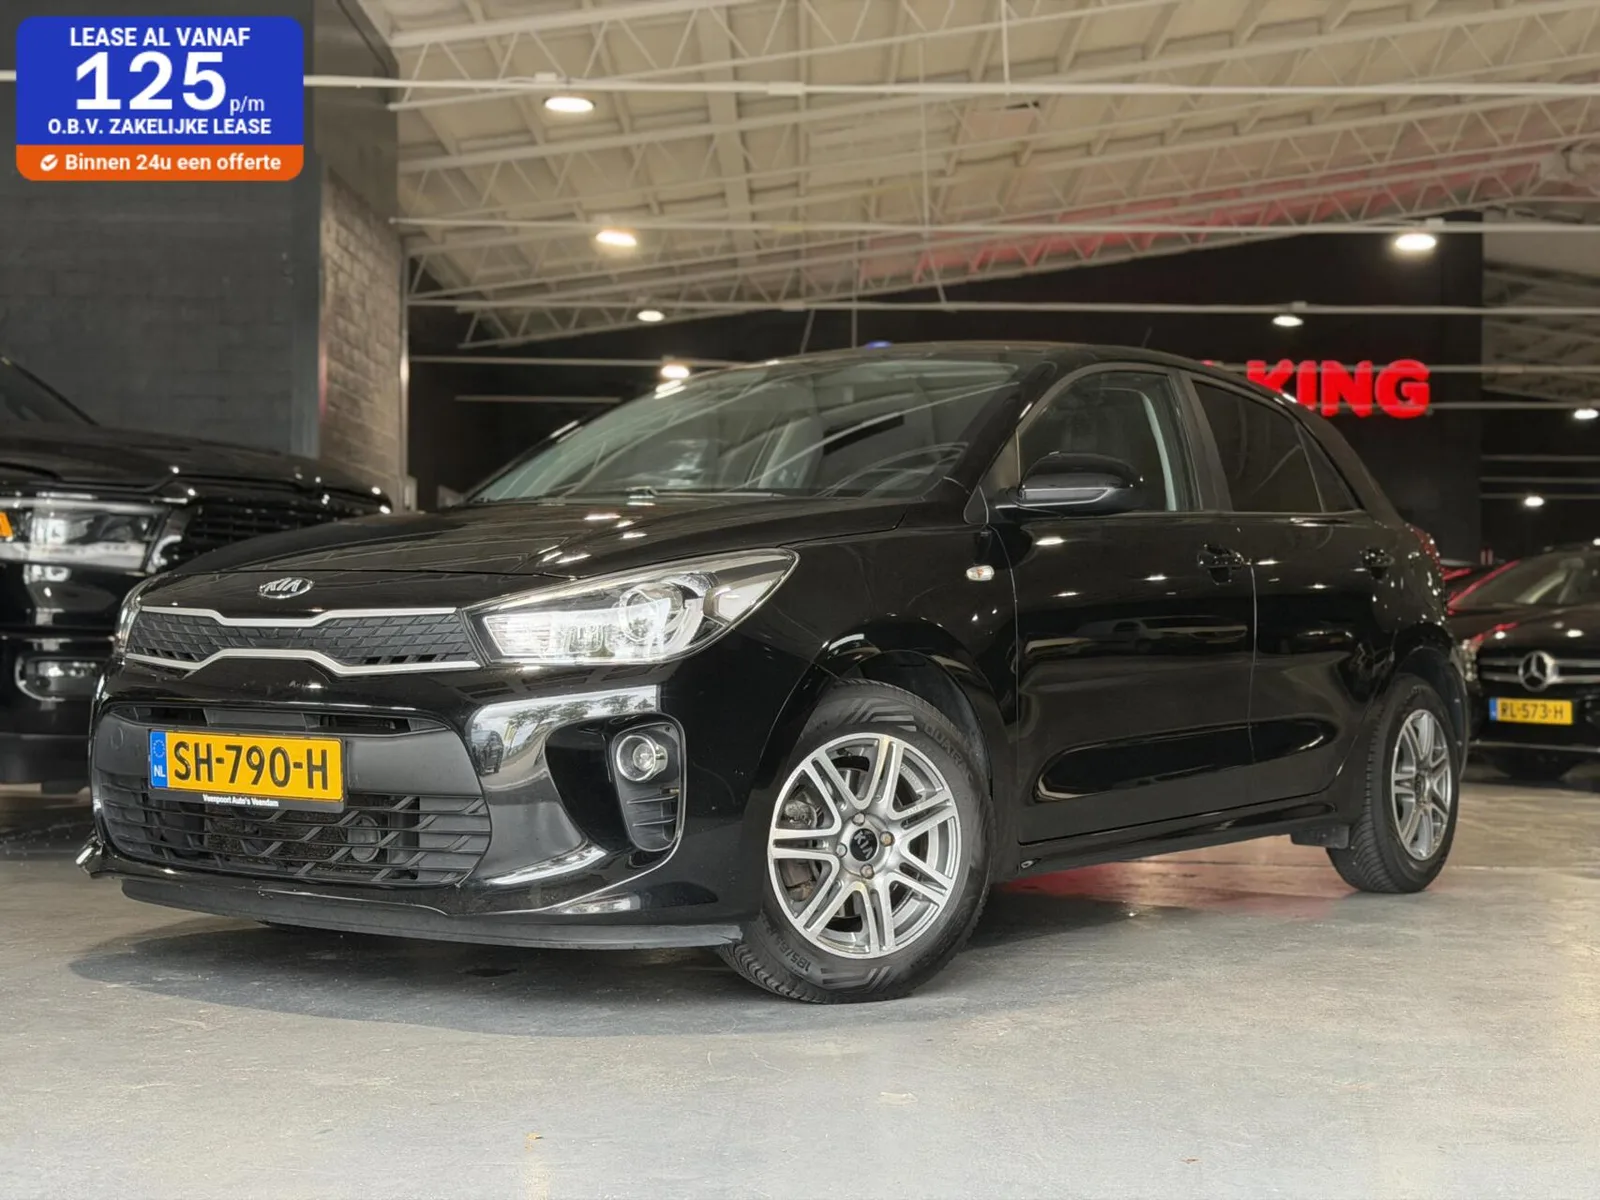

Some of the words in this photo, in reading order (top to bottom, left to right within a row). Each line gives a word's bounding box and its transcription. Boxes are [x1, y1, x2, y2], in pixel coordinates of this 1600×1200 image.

[1246, 359, 1430, 418] KING
[1500, 702, 1564, 720] RL-573-H
[153, 764, 166, 778] NL
[173, 740, 329, 791] SH-790-H
[853, 830, 873, 860] KIA
